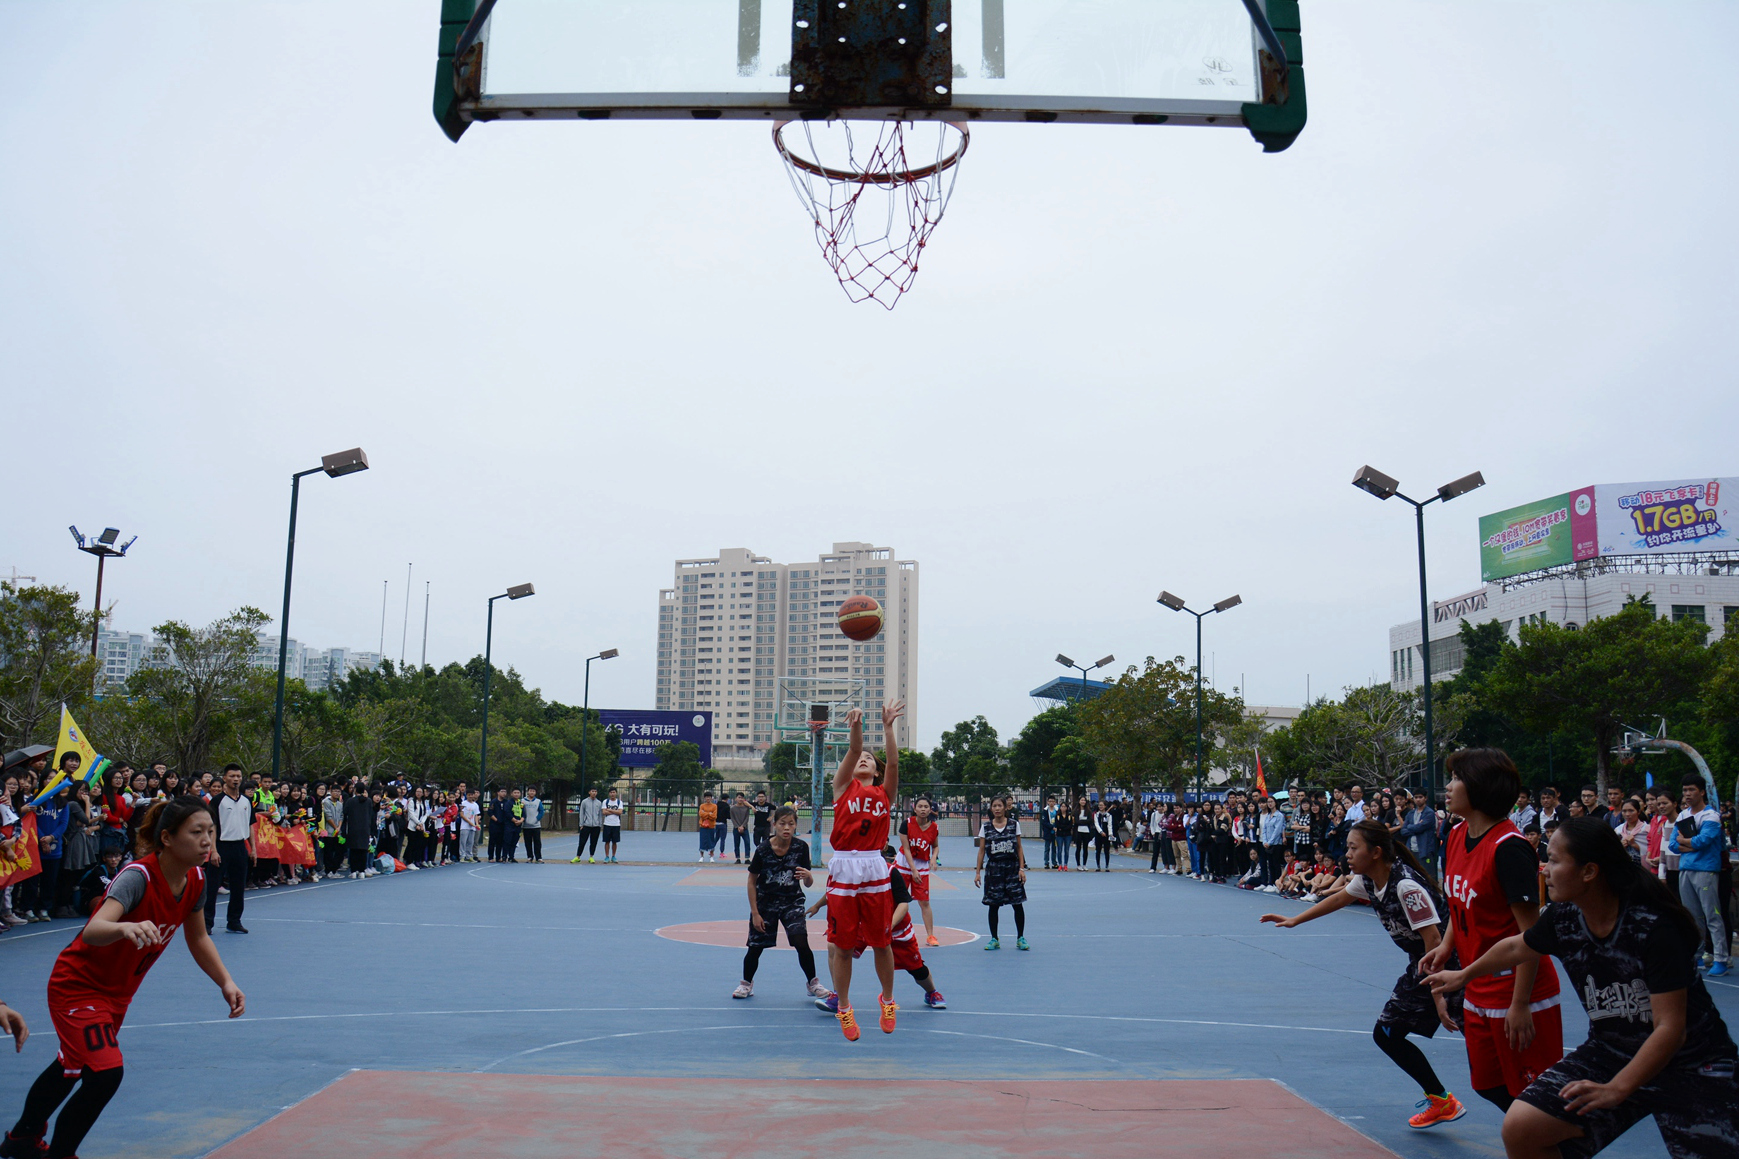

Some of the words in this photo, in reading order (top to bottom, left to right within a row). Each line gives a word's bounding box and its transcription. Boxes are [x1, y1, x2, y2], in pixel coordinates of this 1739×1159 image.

[847, 797, 888, 817] WEST
[859, 819, 872, 836] 9
[83, 1023, 118, 1052] 00
